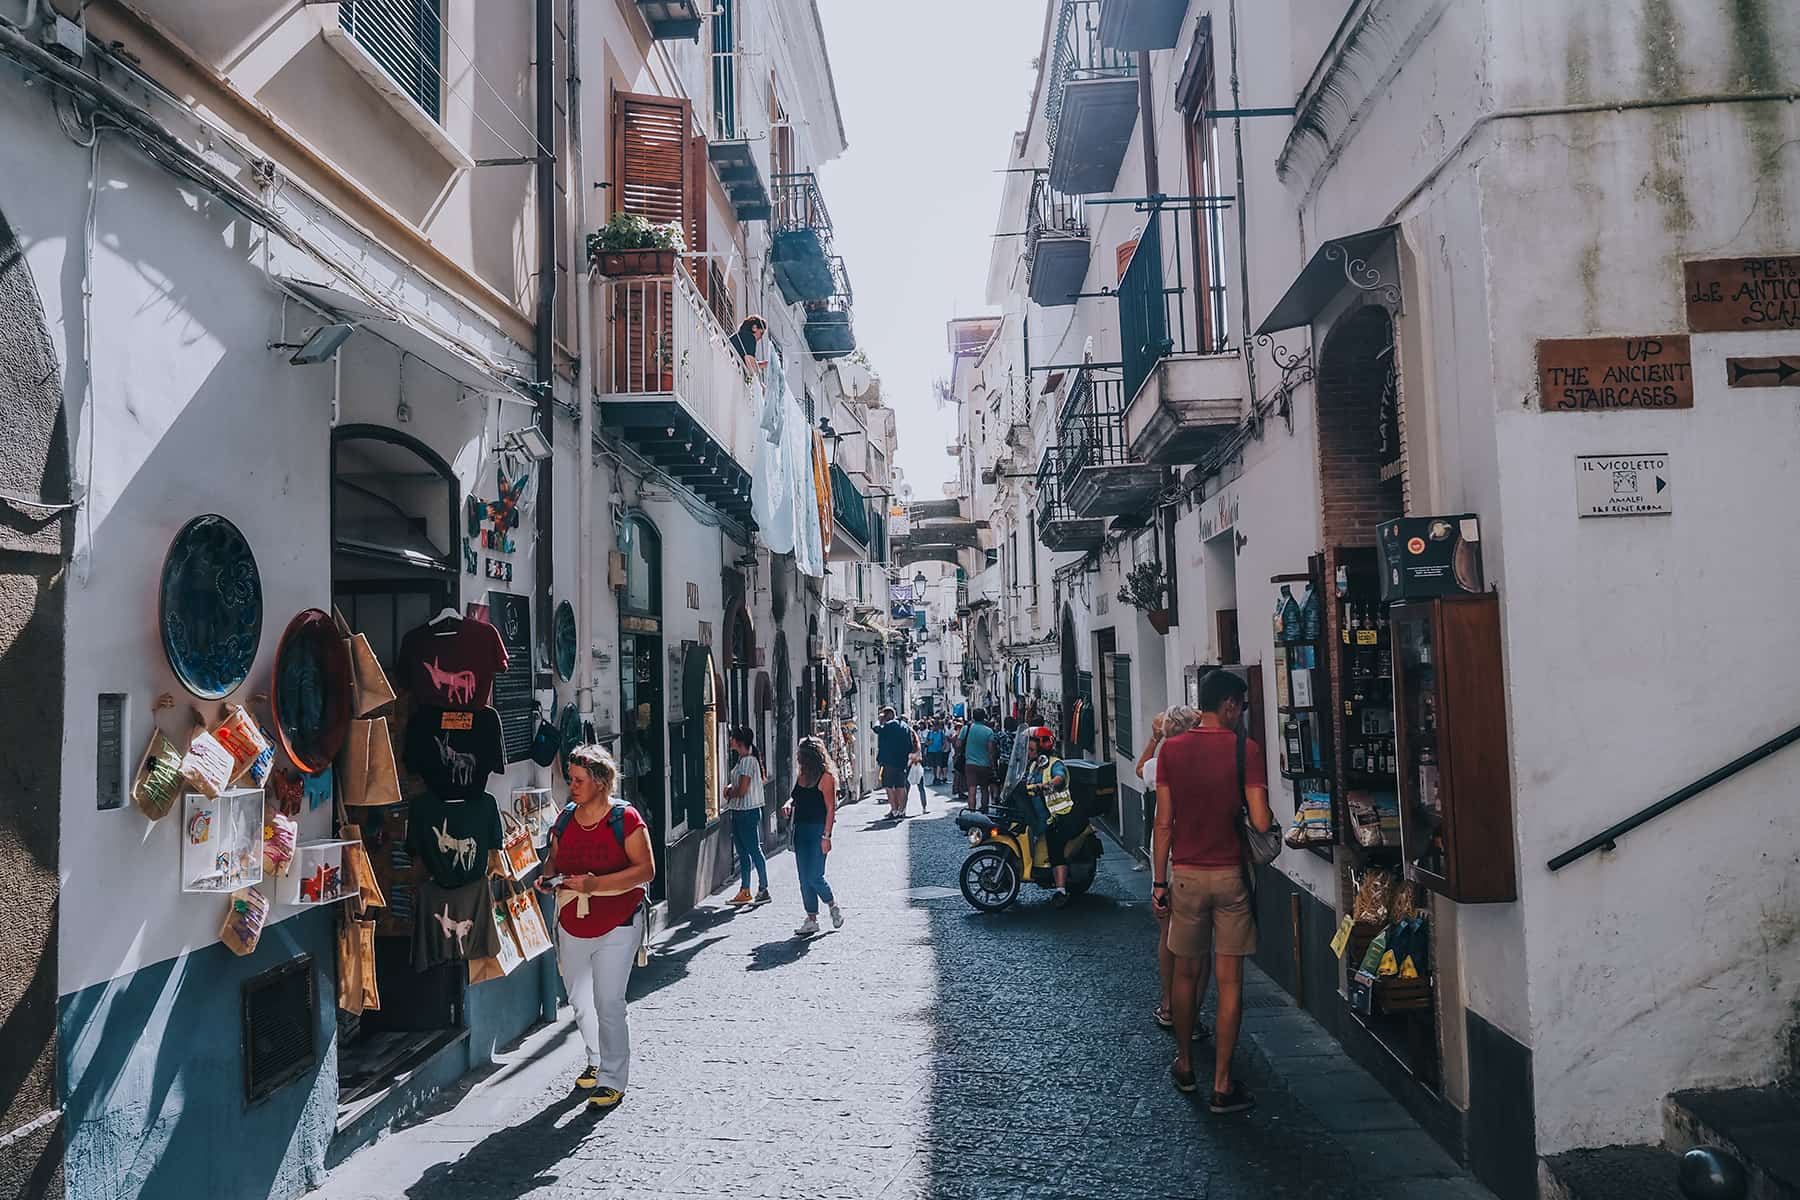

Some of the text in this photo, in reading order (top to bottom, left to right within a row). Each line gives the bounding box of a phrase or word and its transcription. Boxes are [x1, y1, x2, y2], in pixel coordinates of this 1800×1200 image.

[1744, 259, 1796, 278] PER
[1692, 279, 1800, 303] LE ANTIC
[1626, 340, 1663, 361] UP
[1548, 363, 1691, 386] THE ANCIENT
[1558, 386, 1678, 409] STAIRCASES
[1583, 460, 1664, 471] IL VICOLETTO
